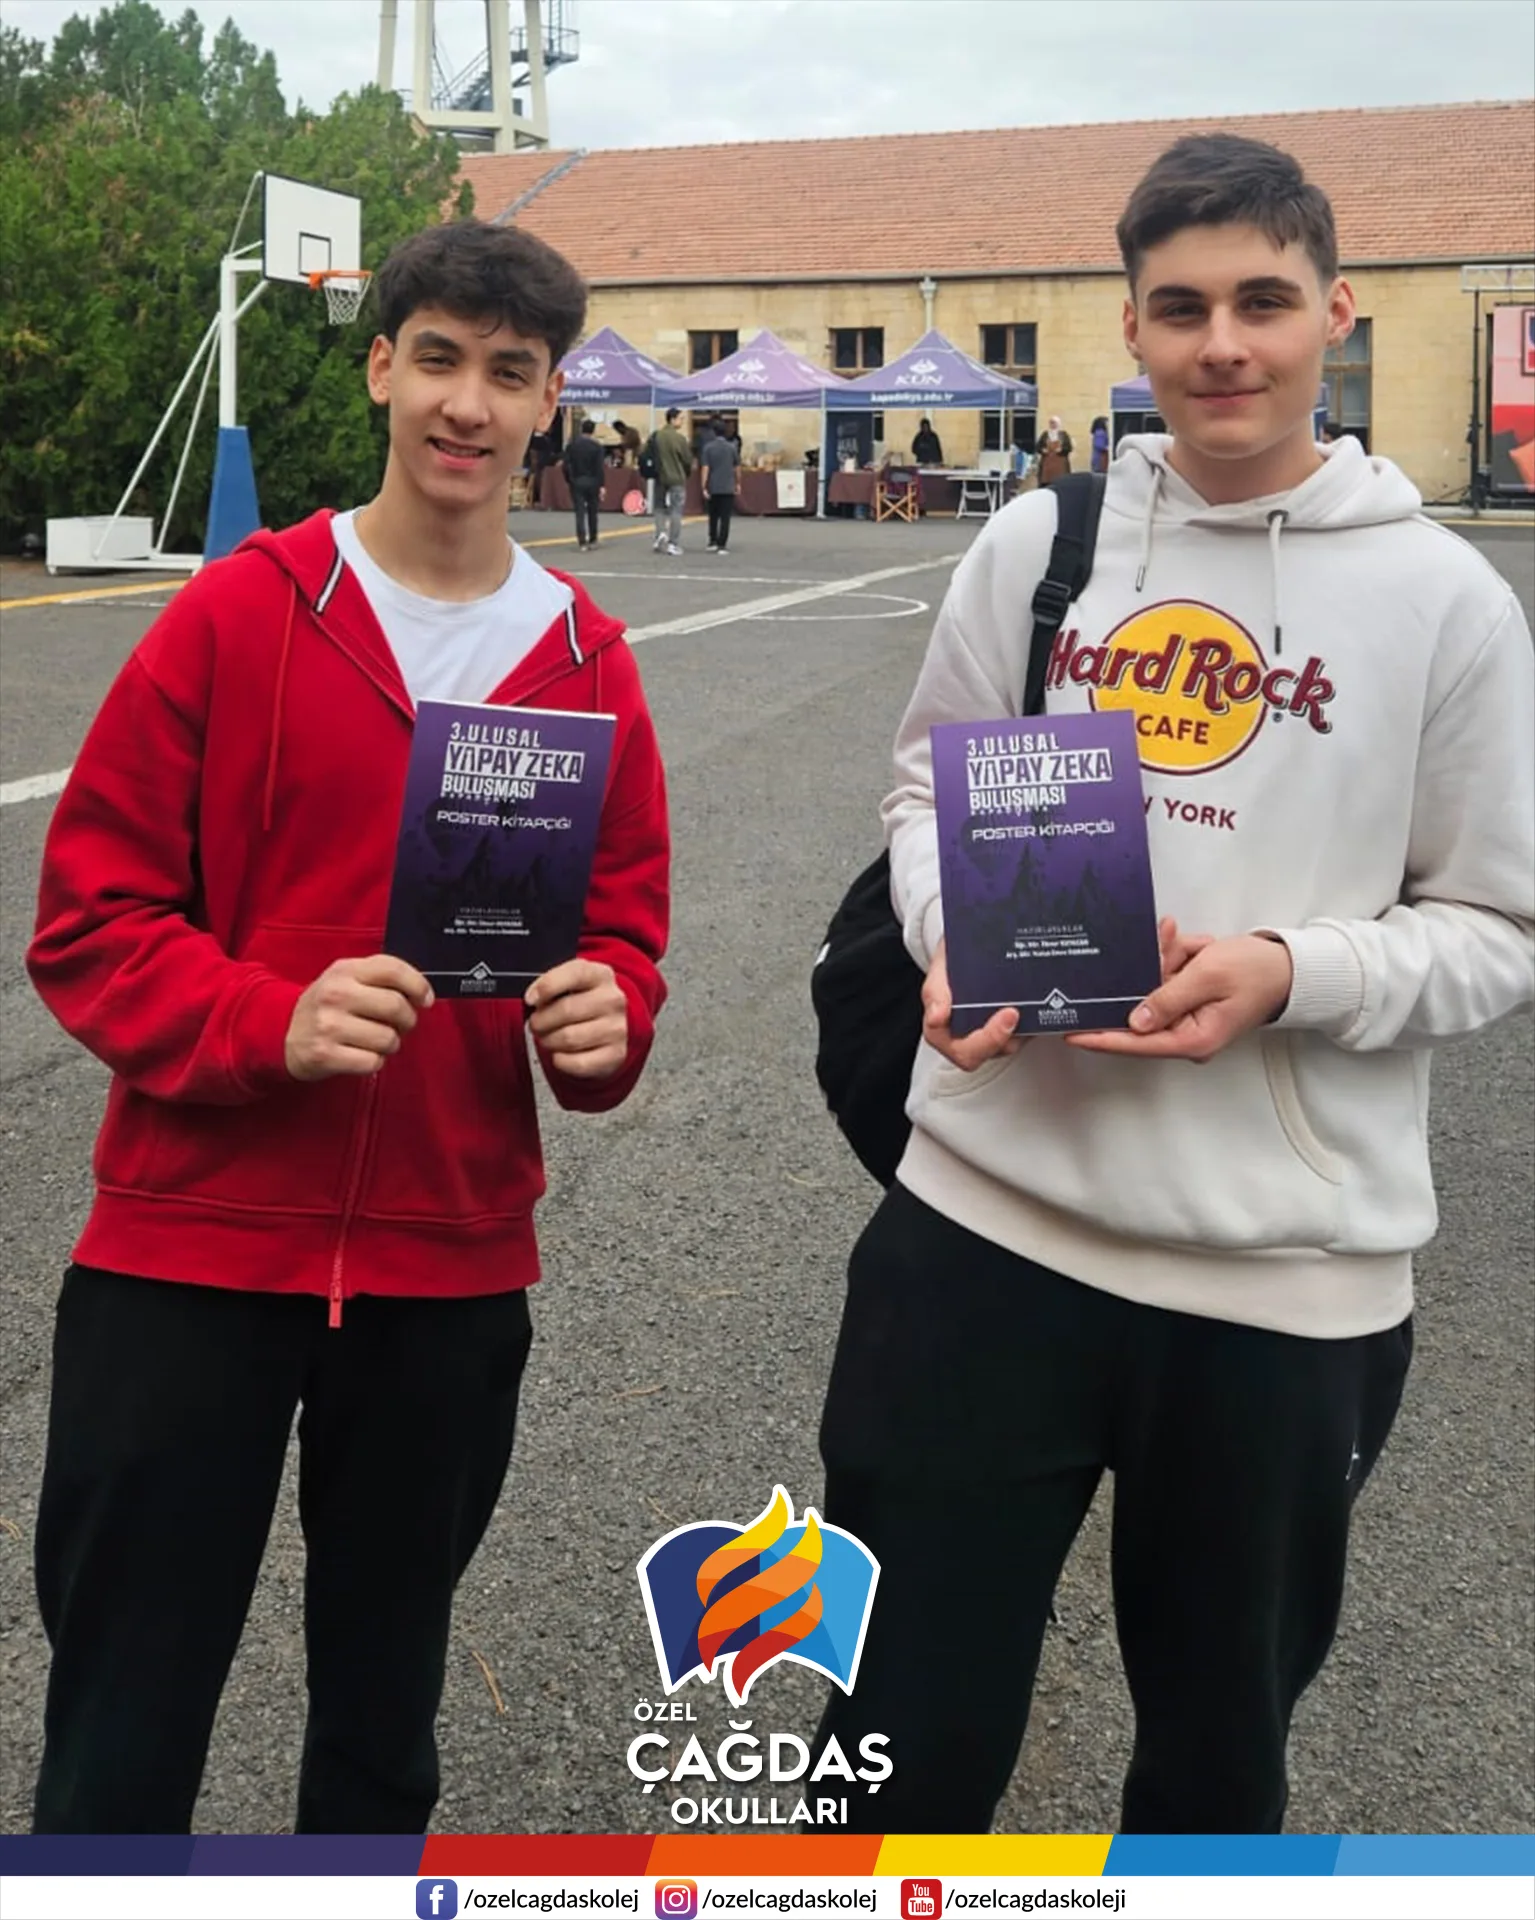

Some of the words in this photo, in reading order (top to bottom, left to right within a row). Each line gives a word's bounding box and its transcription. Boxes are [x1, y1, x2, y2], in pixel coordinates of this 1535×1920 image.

[1045, 629, 1184, 695] Hard
[1180, 637, 1335, 733] Rock
[450, 721, 541, 748] 3.ULUSAL
[1136, 714, 1210, 745] CAFE
[967, 733, 1060, 756] 3.ULUSAL
[525, 751, 583, 780] ZEKA
[1049, 752, 1112, 782] ZEKA
[437, 810, 500, 826] POSTER
[1163, 797, 1237, 831] YORK
[972, 825, 1036, 841] POSTER
[1039, 818, 1115, 836] KİTAPÇIĞI
